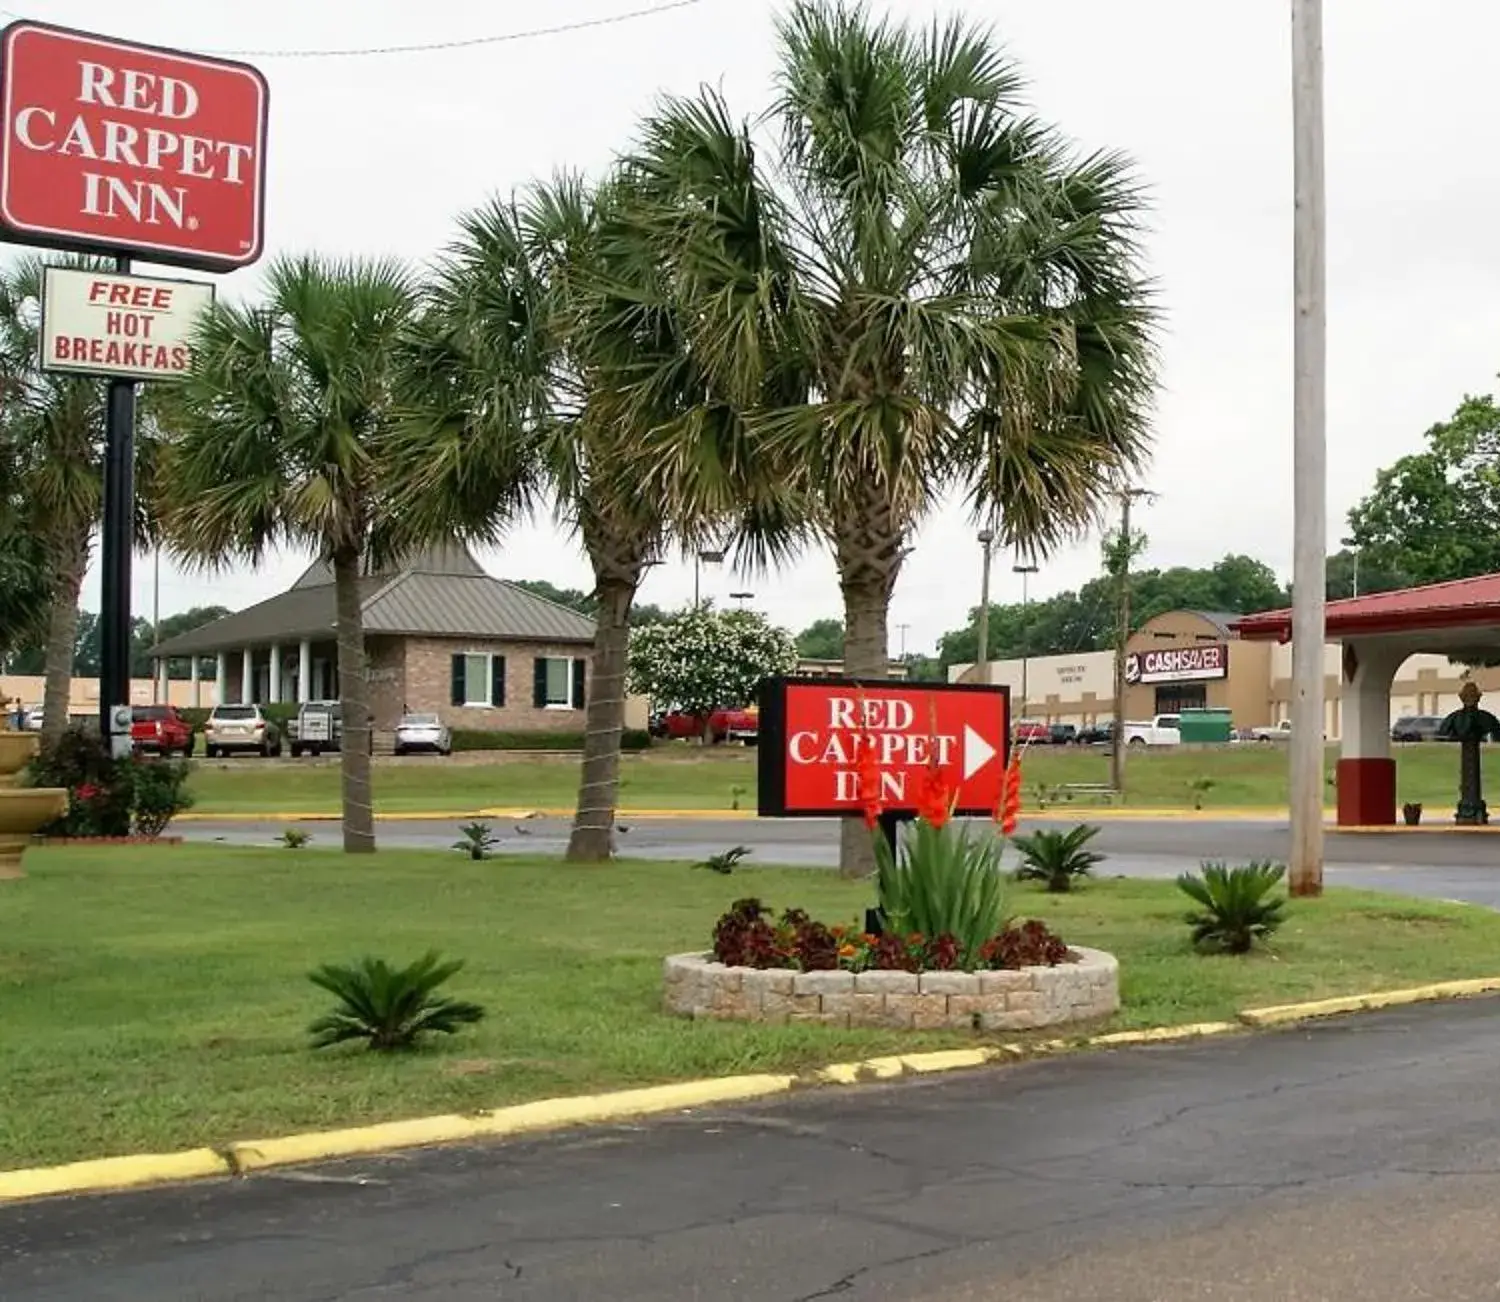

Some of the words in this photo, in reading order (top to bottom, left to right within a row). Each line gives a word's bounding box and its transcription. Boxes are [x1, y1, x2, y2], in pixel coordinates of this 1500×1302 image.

[76, 61, 199, 120] RED
[15, 107, 252, 184] CARPET
[89, 281, 173, 308] FREE
[107, 312, 154, 338] HOT
[55, 336, 190, 371] BREAKFAS
[827, 697, 914, 730] RED
[833, 771, 908, 801] IN
